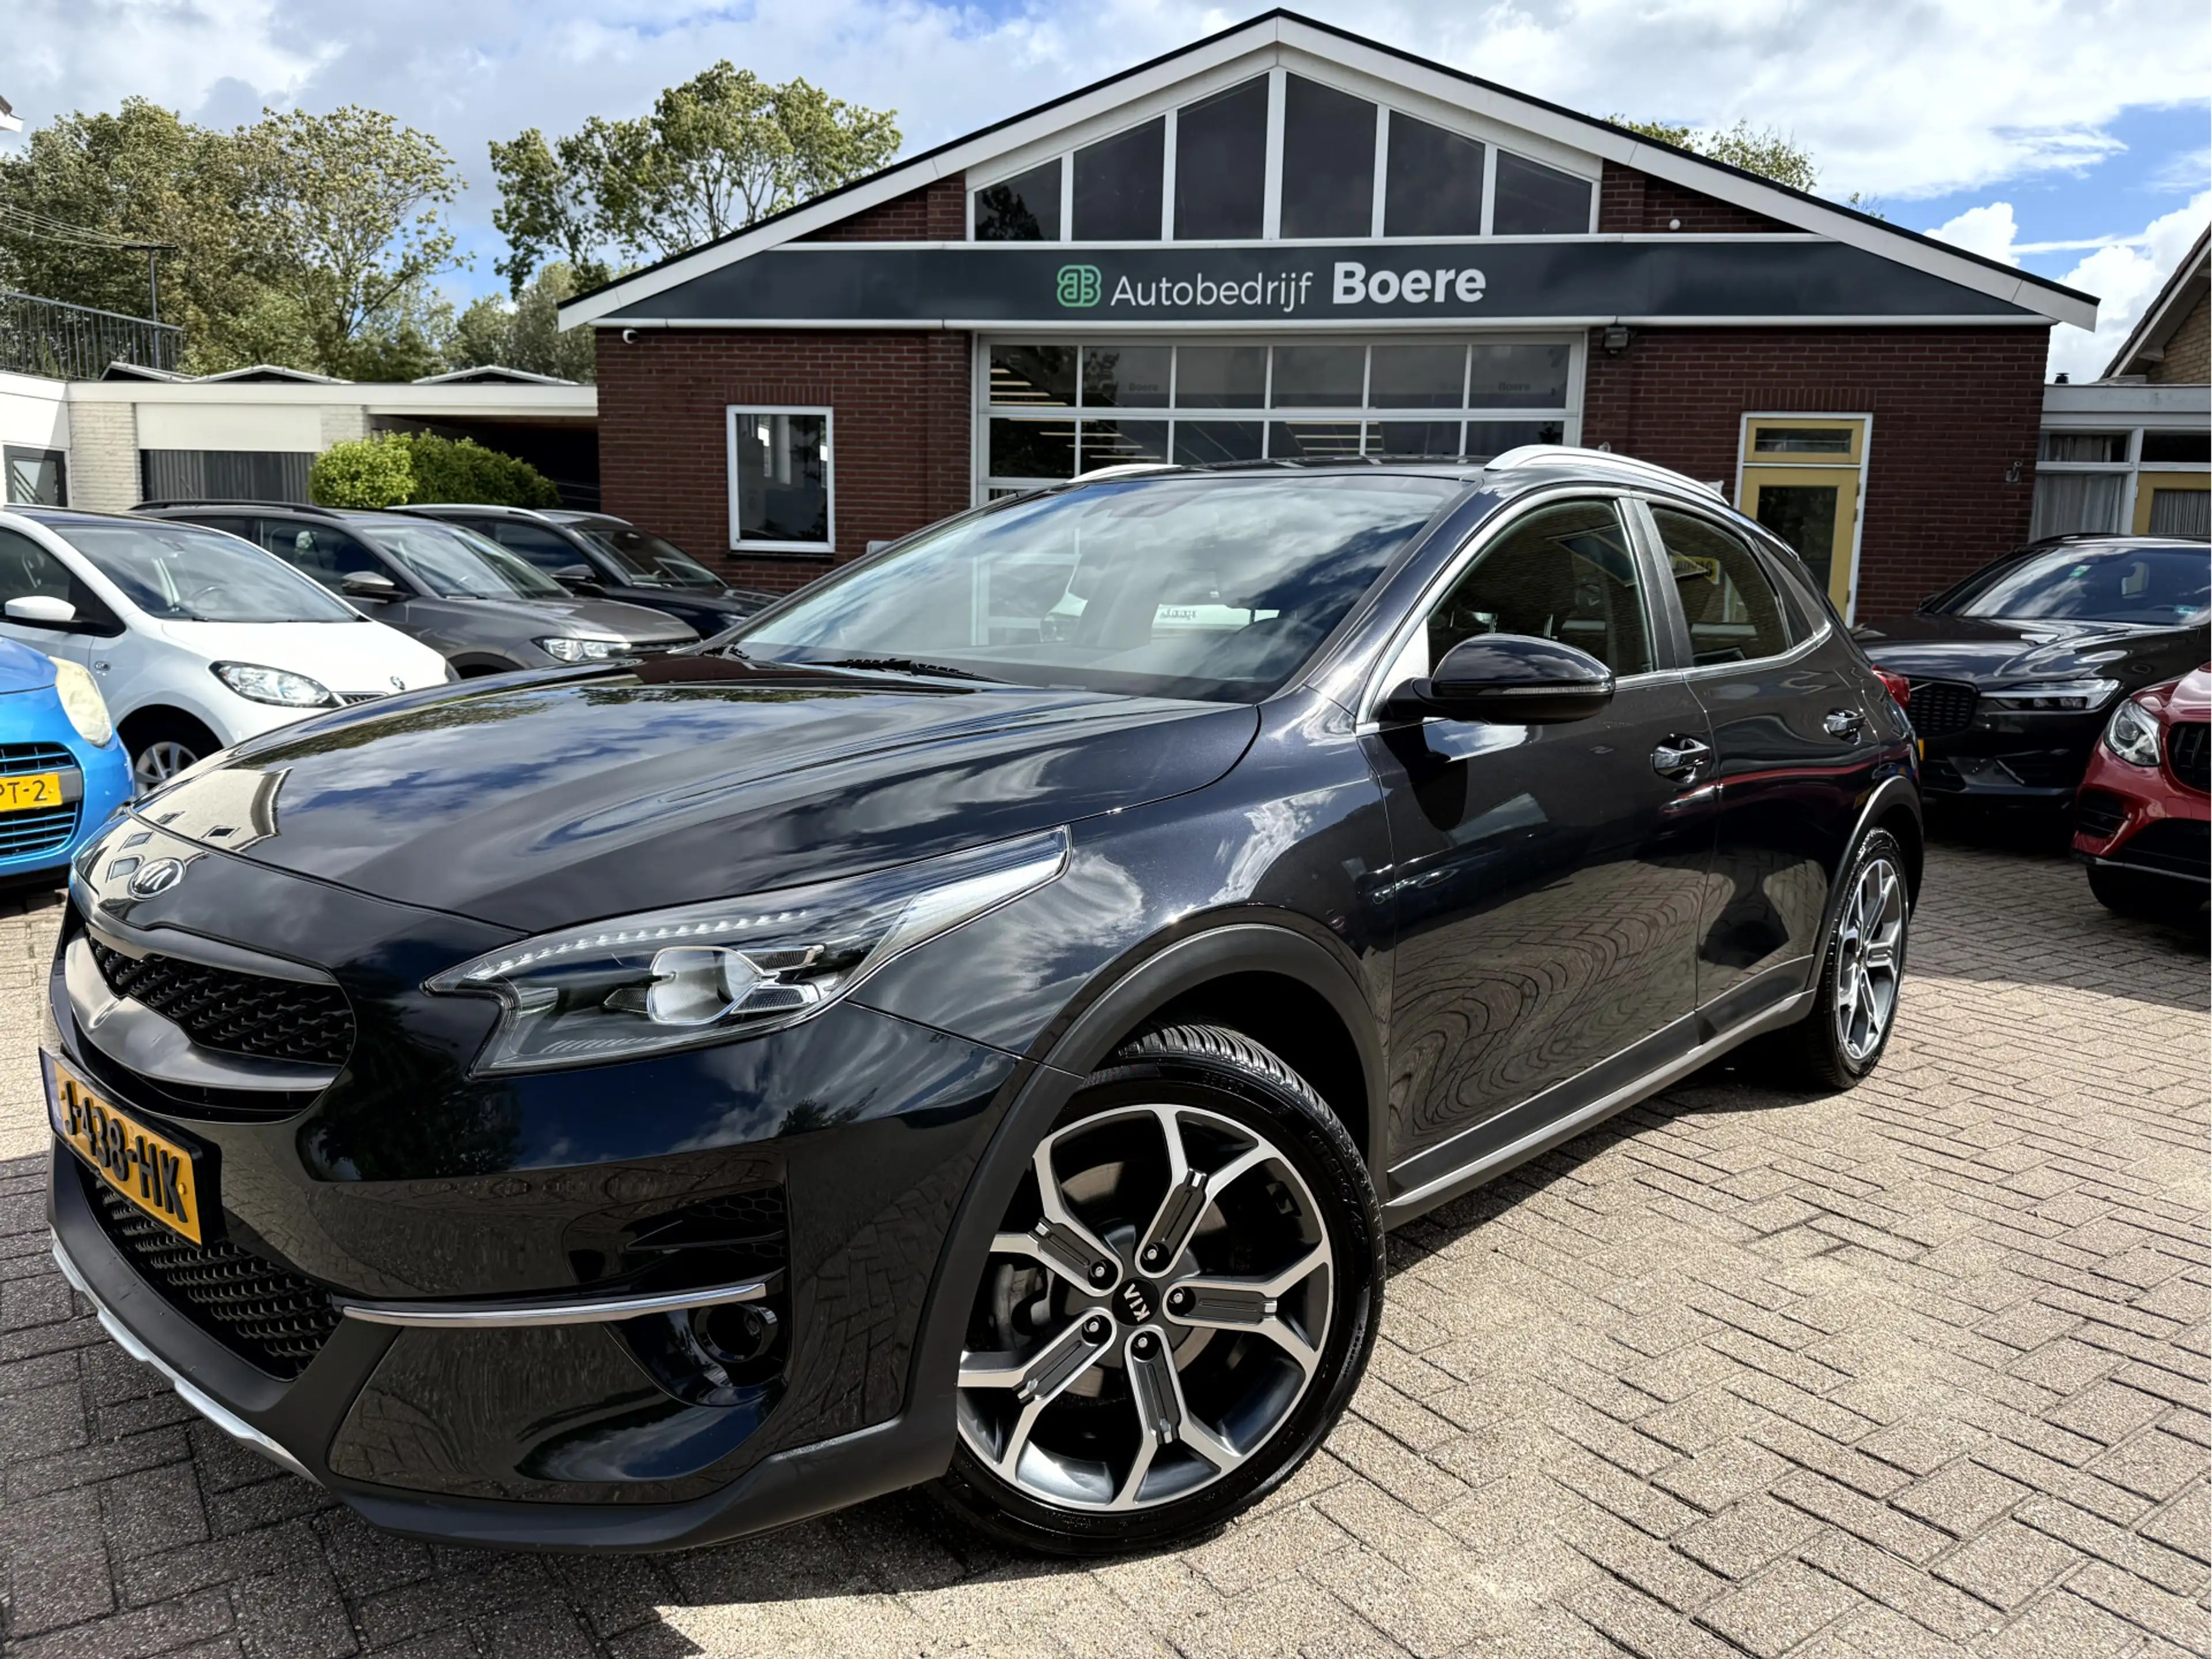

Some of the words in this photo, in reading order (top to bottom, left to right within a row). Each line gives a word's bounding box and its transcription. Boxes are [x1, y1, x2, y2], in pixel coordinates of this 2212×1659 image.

[1111, 271, 1313, 312] Autobedrijf
[1332, 261, 1486, 304] Boere
[1123, 1282, 1151, 1323] KIA
